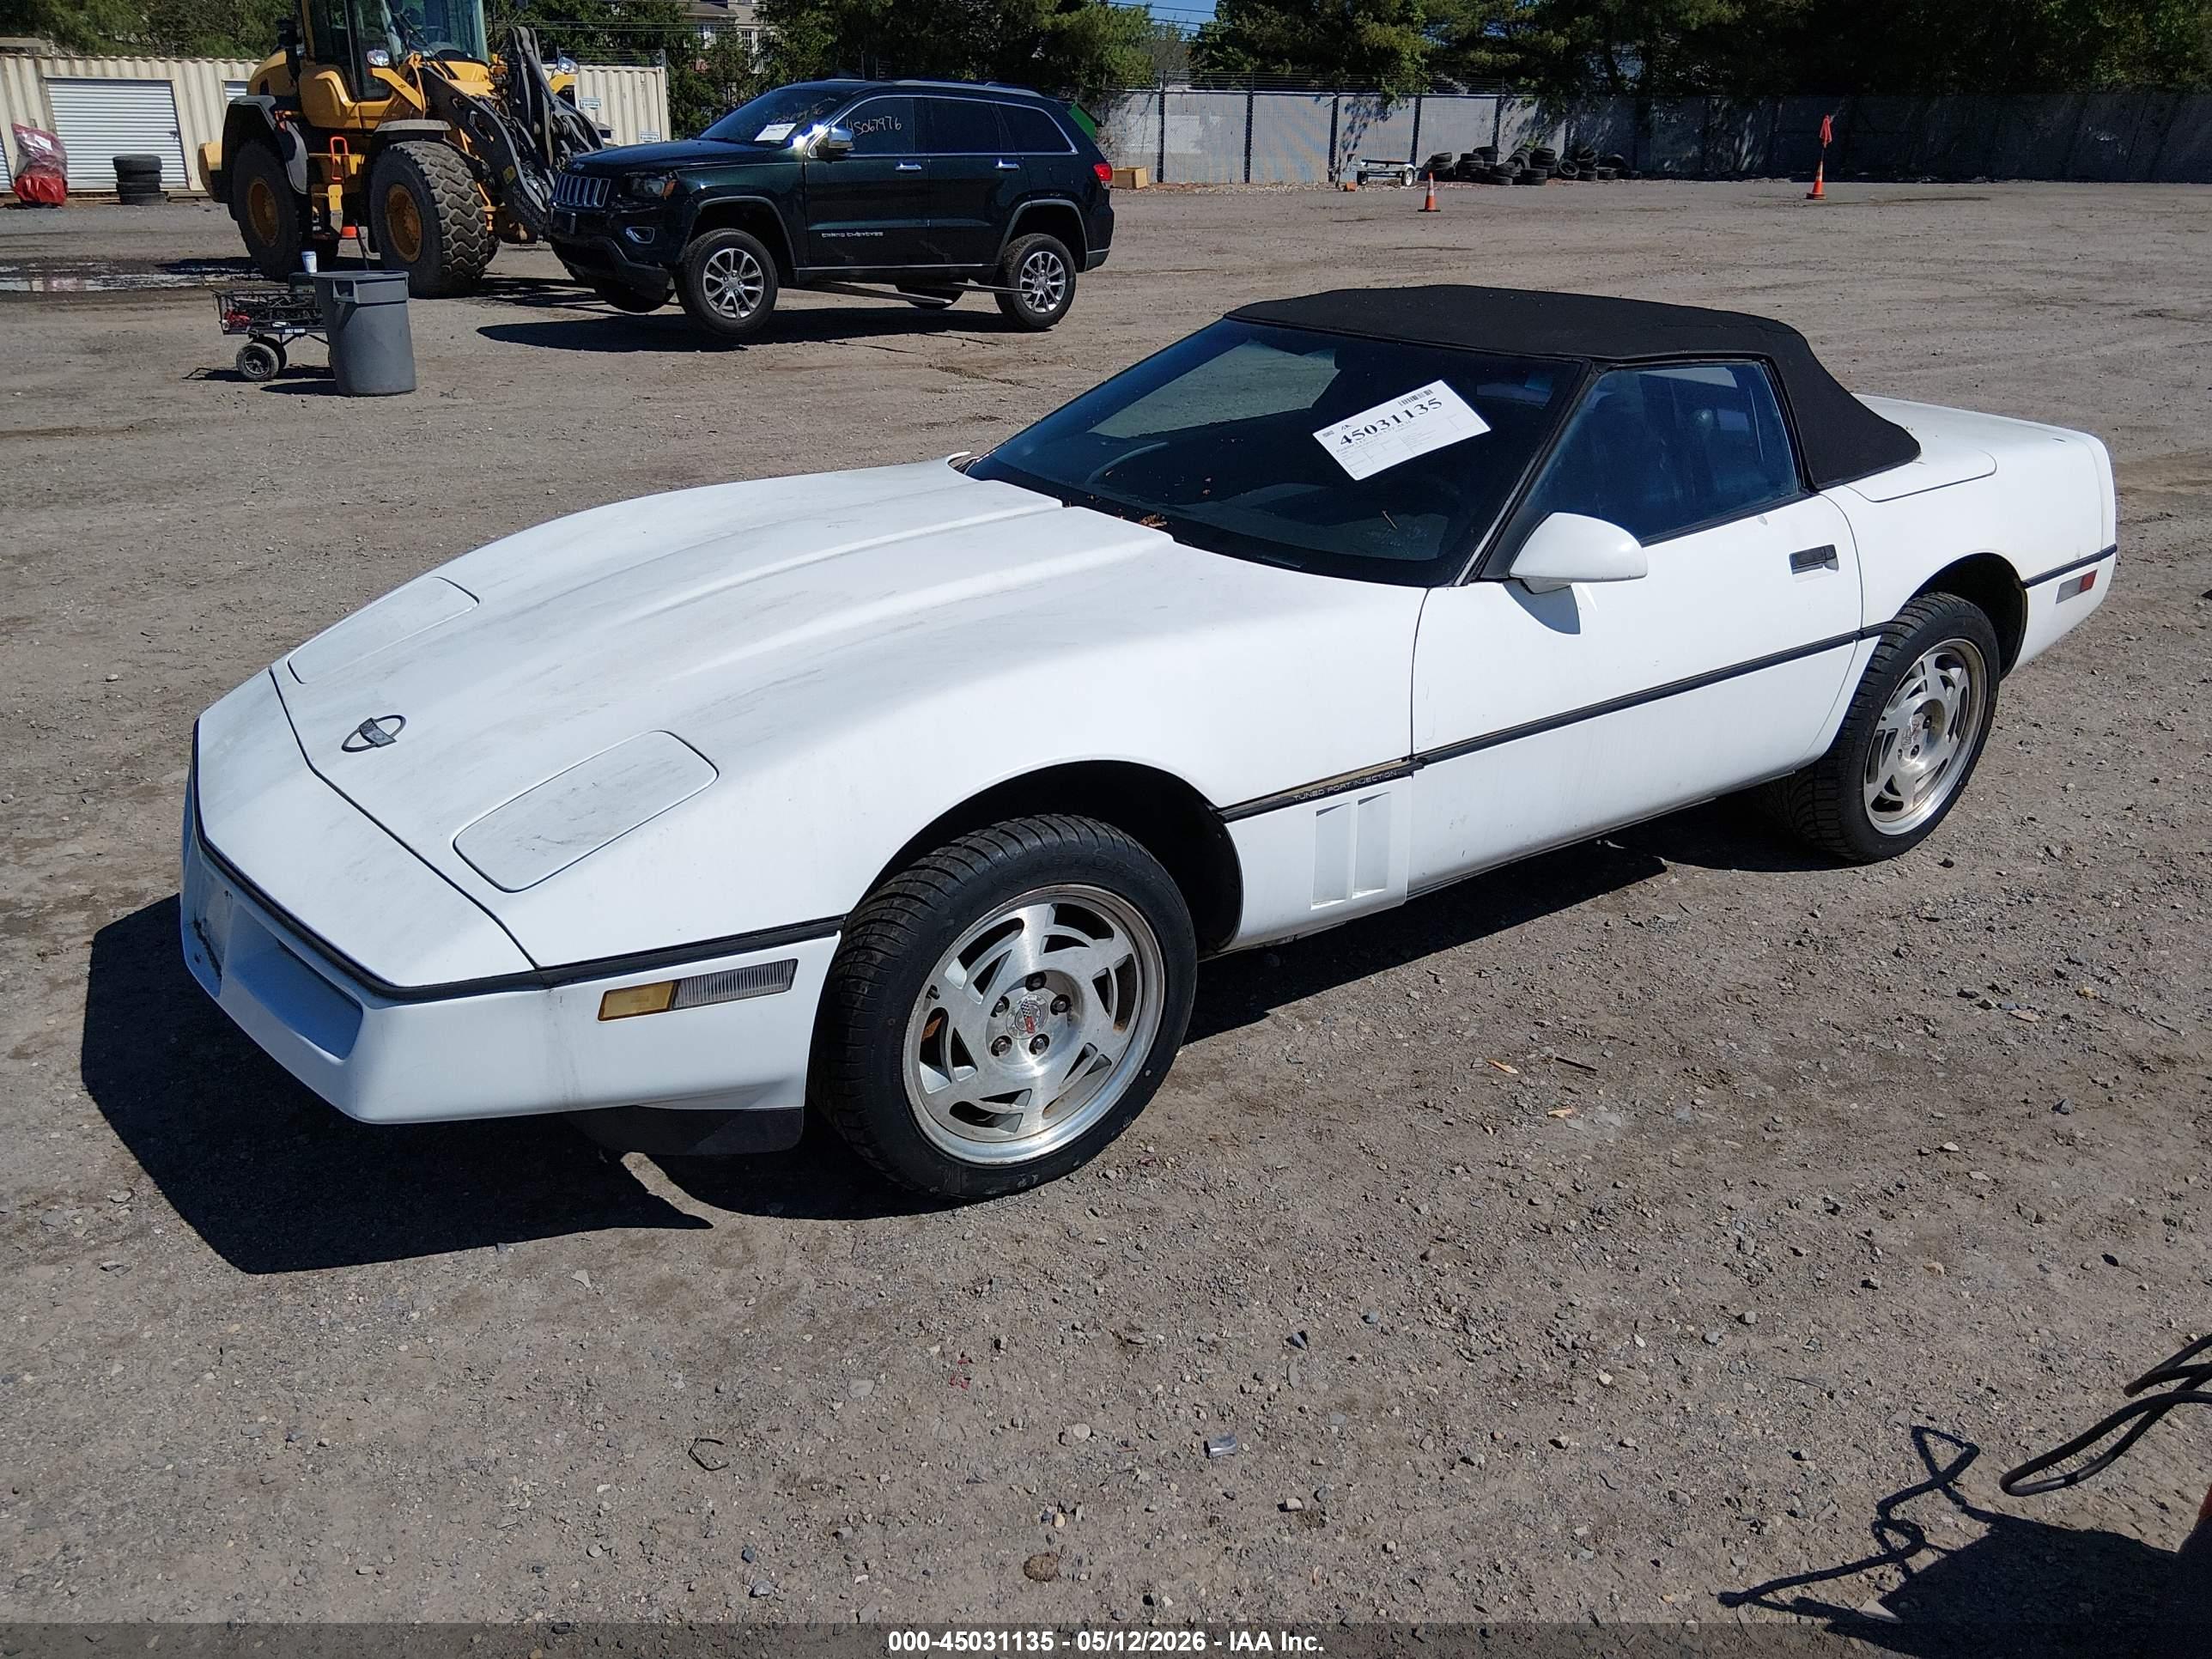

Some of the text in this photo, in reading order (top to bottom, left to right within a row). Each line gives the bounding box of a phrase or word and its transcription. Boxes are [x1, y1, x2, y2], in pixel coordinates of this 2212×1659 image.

[846, 115, 902, 136] 45067976
[1340, 398, 1443, 447] 45031135
[1293, 770, 1397, 801] TUNED PORT INJECTION
